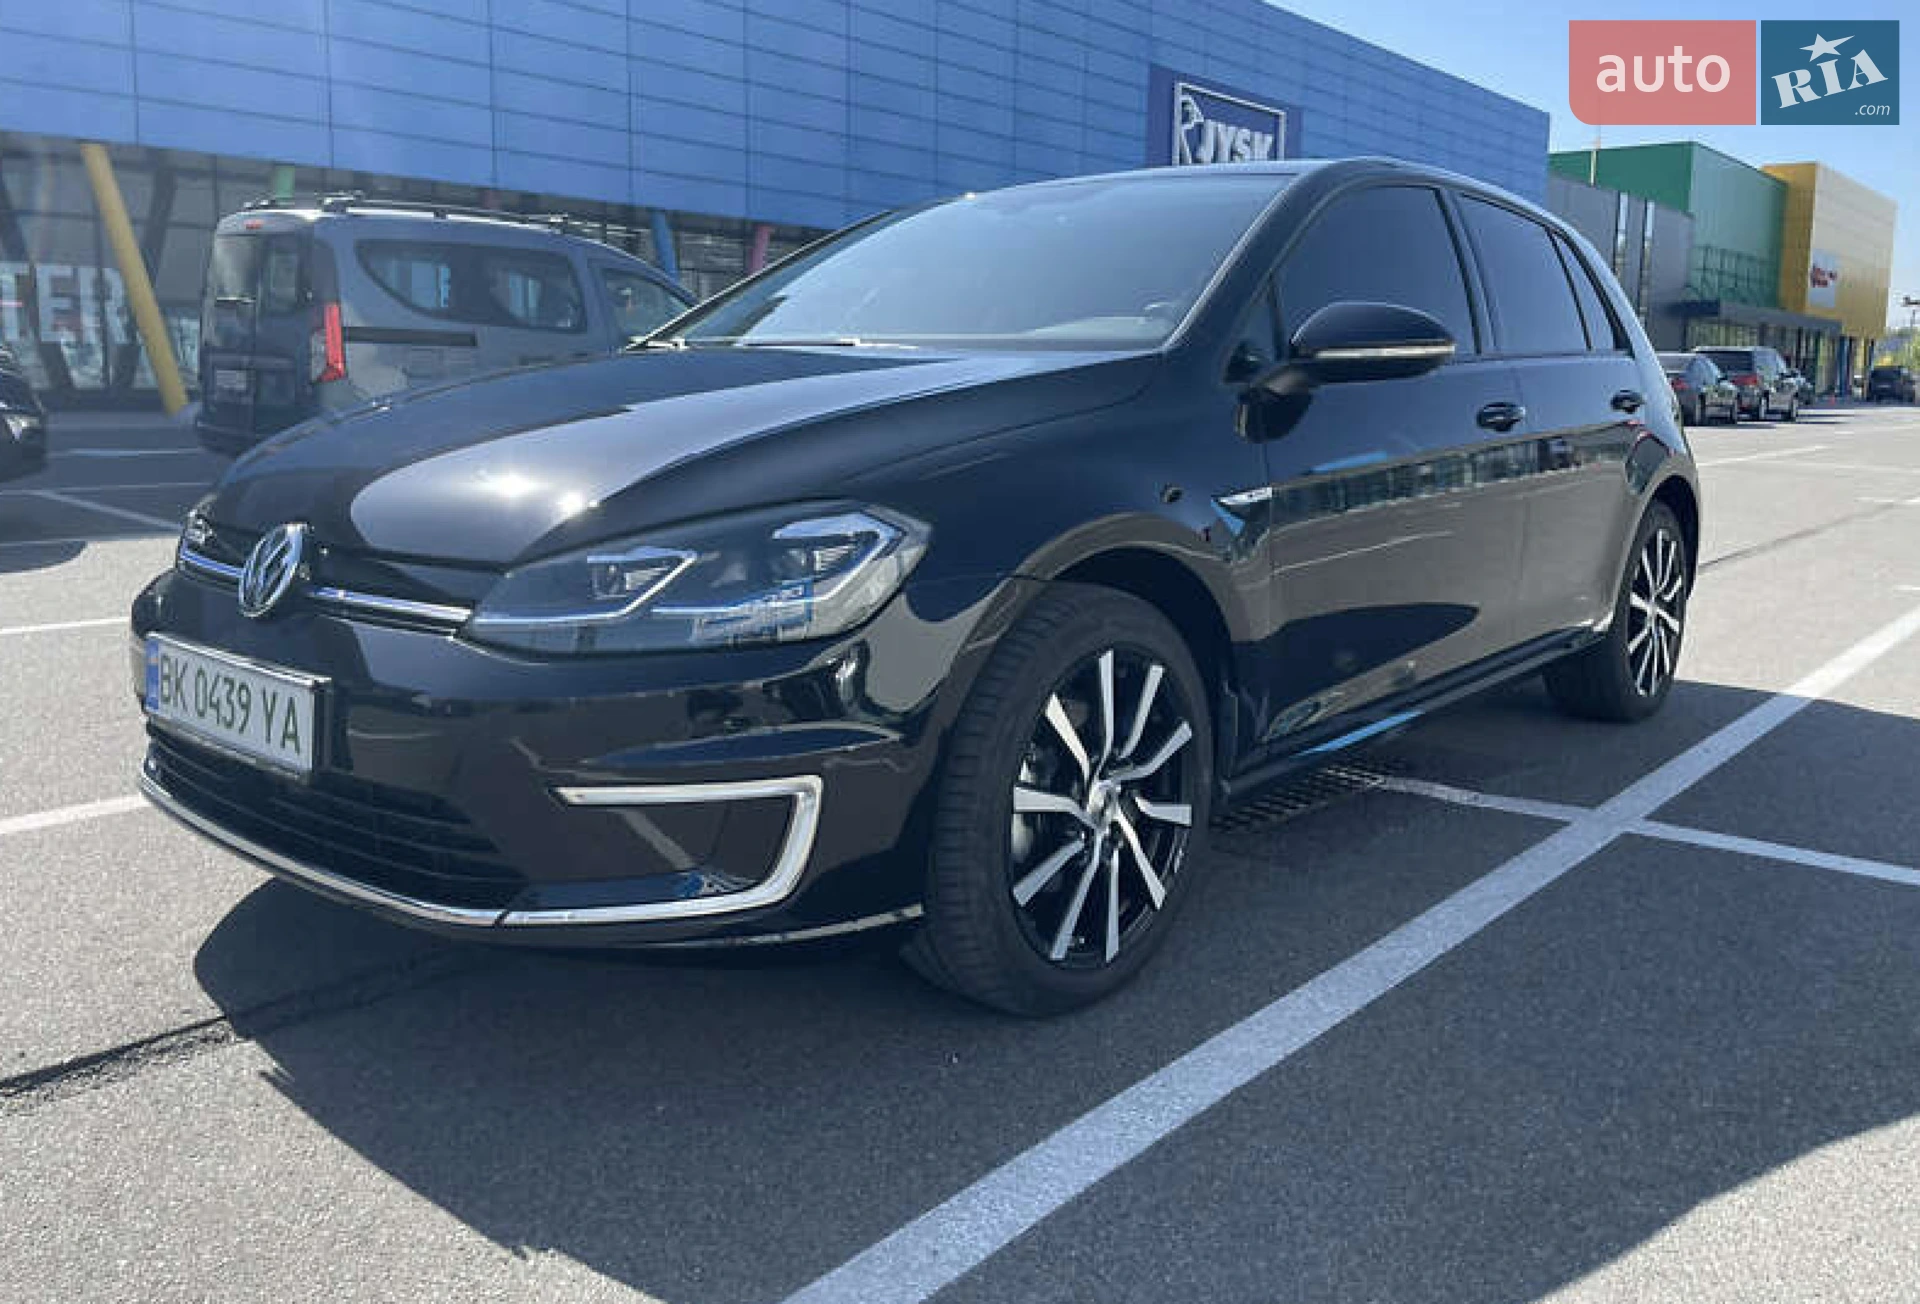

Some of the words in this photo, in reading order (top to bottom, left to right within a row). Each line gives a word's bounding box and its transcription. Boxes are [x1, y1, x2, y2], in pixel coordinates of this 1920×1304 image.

[1197, 118, 1273, 164] JYSK
[160, 654, 189, 713] BK
[195, 665, 251, 735] 0439
[262, 686, 300, 756] YA
